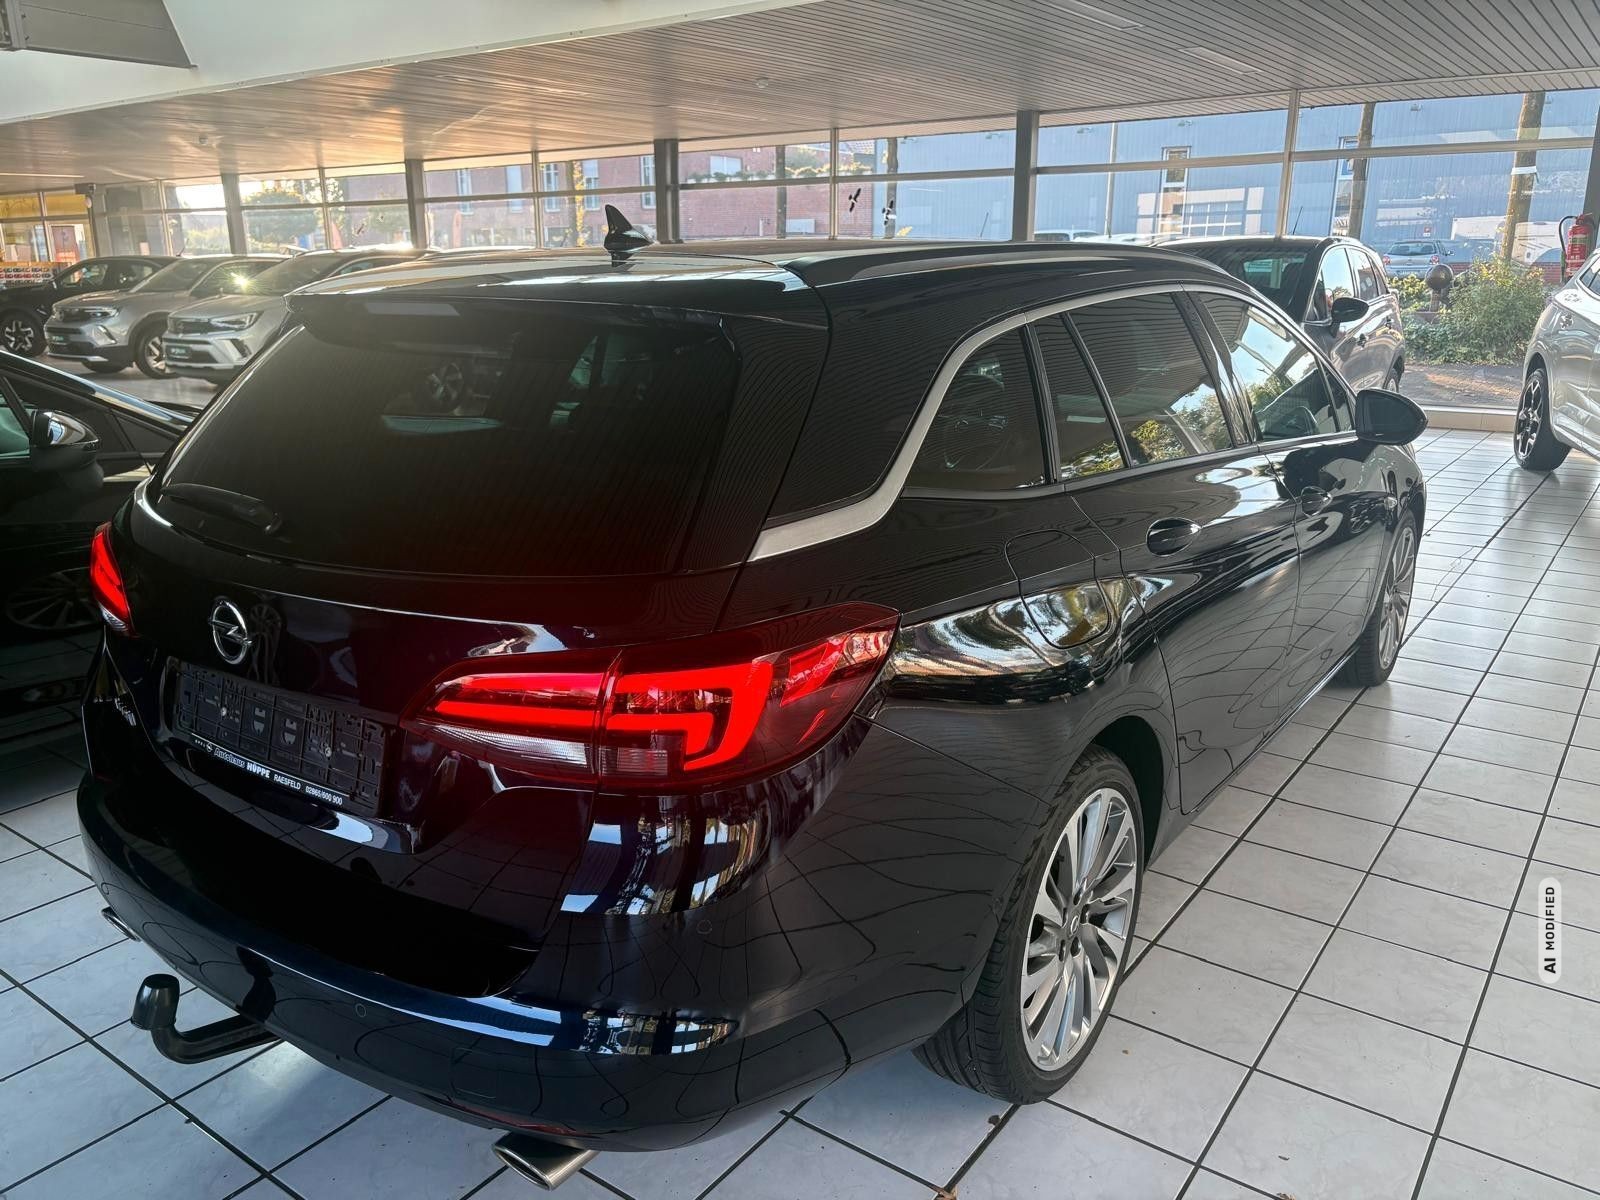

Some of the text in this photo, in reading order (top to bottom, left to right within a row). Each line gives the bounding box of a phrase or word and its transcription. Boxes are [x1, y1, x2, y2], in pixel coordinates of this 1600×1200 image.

[246, 761, 271, 779] HÜPPE
[273, 774, 302, 790] RAESFELD
[332, 794, 343, 806] 900
